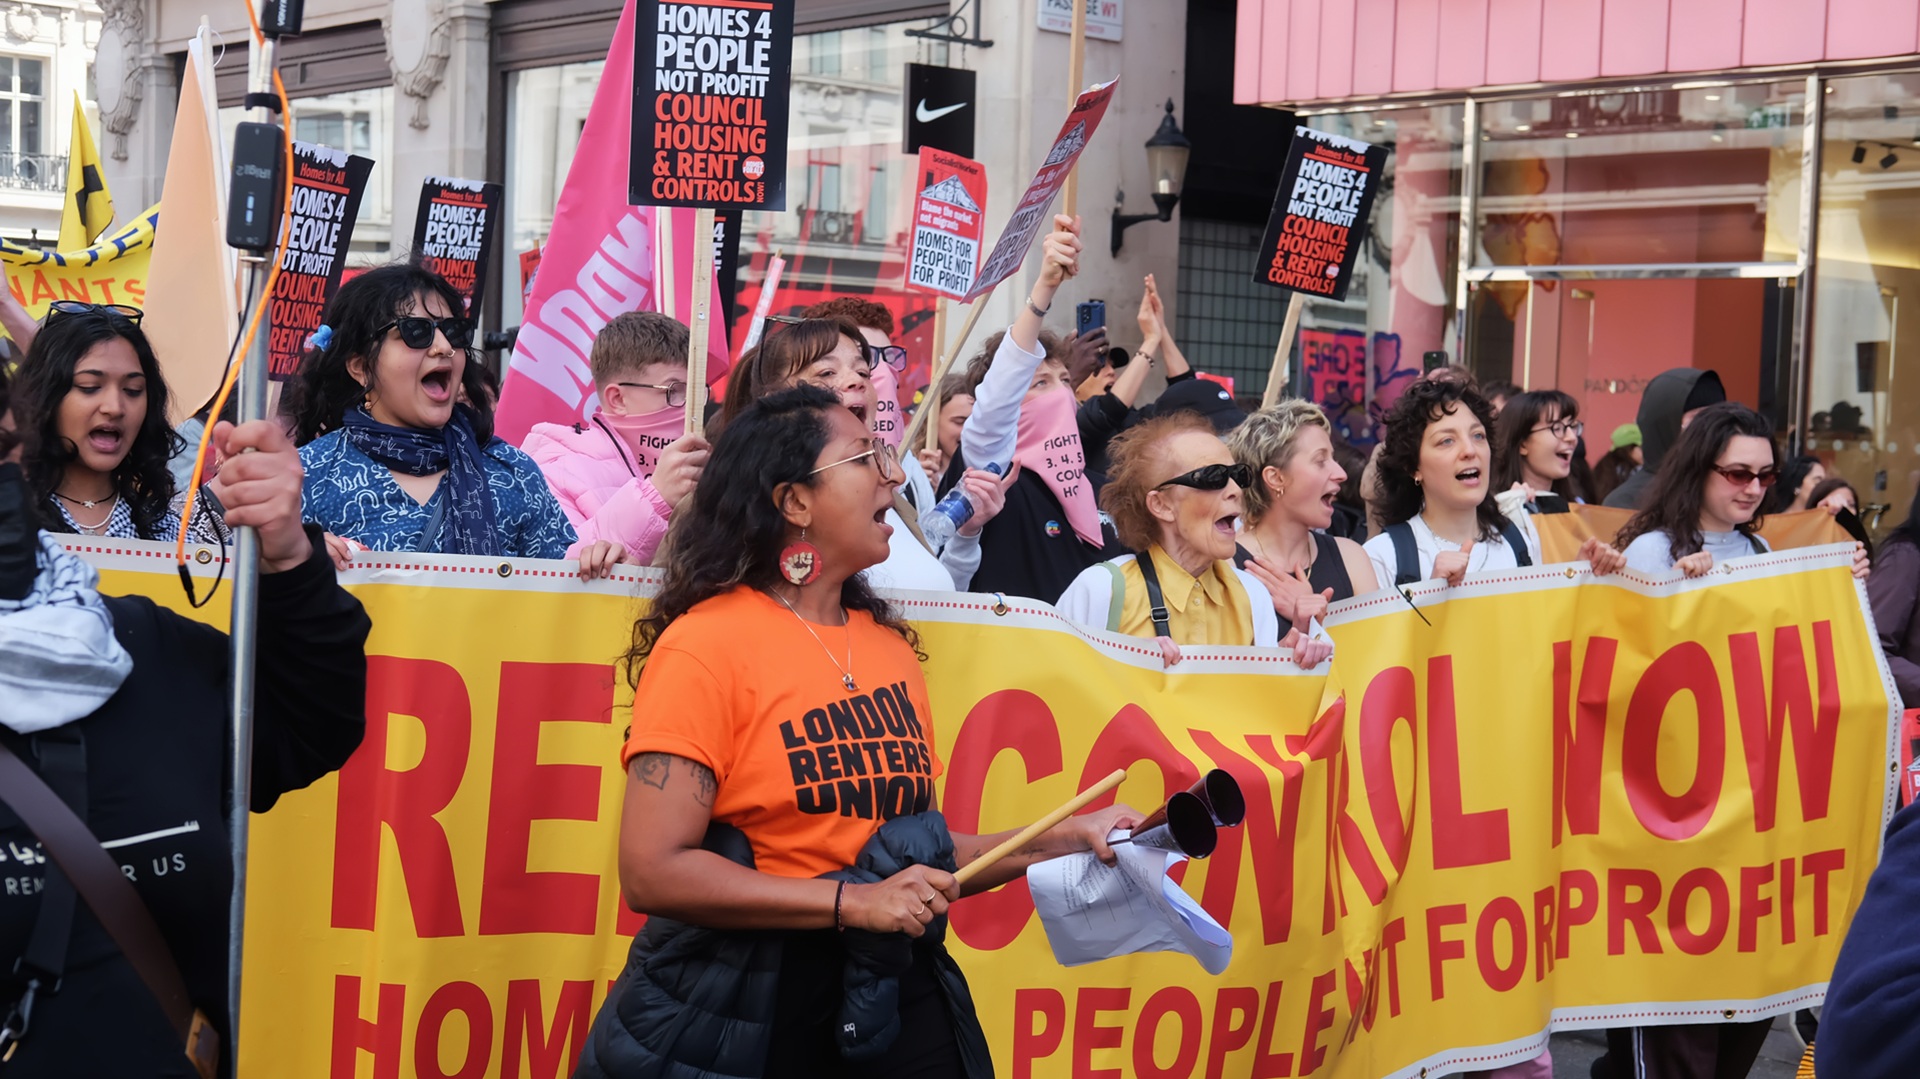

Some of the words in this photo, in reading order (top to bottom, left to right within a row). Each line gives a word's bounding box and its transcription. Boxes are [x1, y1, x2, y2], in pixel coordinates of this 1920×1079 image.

[658, 4, 750, 38] HOMES
[754, 12, 772, 39] 4
[1102, 2, 1117, 18] W1
[656, 34, 772, 74] PEOPLE
[656, 69, 698, 92] NOT
[701, 72, 769, 97] PROFIT
[655, 93, 767, 126] COUNCIL
[654, 122, 766, 154] HOUSING
[652, 151, 671, 176] &
[677, 152, 738, 178] RENT
[1315, 144, 1342, 160] Homes
[1344, 151, 1354, 164] for
[1355, 155, 1366, 166] All
[300, 163, 326, 181] Homes
[335, 171, 346, 185] All
[1298, 158, 1356, 188] HOMES
[1355, 172, 1368, 191] 4
[441, 189, 464, 202] Homes
[465, 192, 474, 202] for
[474, 193, 482, 203] All
[652, 177, 755, 202] CONTROLS
[756, 182, 764, 203] NOW!
[1291, 177, 1362, 214] PEOPLE
[291, 186, 336, 220] HOMES
[335, 196, 346, 222] 4
[428, 203, 476, 225] HOMES
[477, 208, 486, 226] 4
[921, 200, 942, 214] Blame
[943, 206, 953, 218] the
[1287, 200, 1316, 218] NOT
[1315, 208, 1356, 228] PROFIT
[714, 223, 724, 242] 4
[920, 213, 932, 224] not
[1283, 214, 1349, 246] COUNCIL
[276, 214, 341, 255] PEOPLE
[424, 221, 484, 247] PEOPLE
[918, 230, 952, 252] HOMES
[955, 240, 972, 260] FOR
[1277, 232, 1346, 264] HOUSING
[299, 252, 334, 276] PROFIT
[424, 242, 446, 258] NOT
[447, 246, 480, 261] PROFIT
[915, 248, 952, 271] PEOPLE
[955, 257, 972, 276] NOT
[1272, 250, 1284, 268] &
[1287, 254, 1326, 277] RENT
[270, 272, 327, 304] OUNCIL
[913, 265, 934, 284] FOR
[938, 270, 969, 293] PROFIT
[1268, 267, 1330, 294] CONTROLS
[270, 327, 304, 353] RENT
[1584, 377, 1650, 394] PANDO
[640, 434, 676, 449] FIGH
[1044, 434, 1078, 451] FIGHT
[779, 681, 924, 749] LONDON
[1552, 620, 1841, 848] NOW
[787, 740, 931, 787] RENTERS
[330, 655, 647, 937] RE
[796, 775, 932, 821] UNION
[152, 853, 186, 876] US
[330, 974, 618, 1079] HOM
[1011, 968, 1336, 1079] PEOPLE
[1425, 885, 1554, 1002] FOR
[1555, 849, 1845, 960] PROFIT
